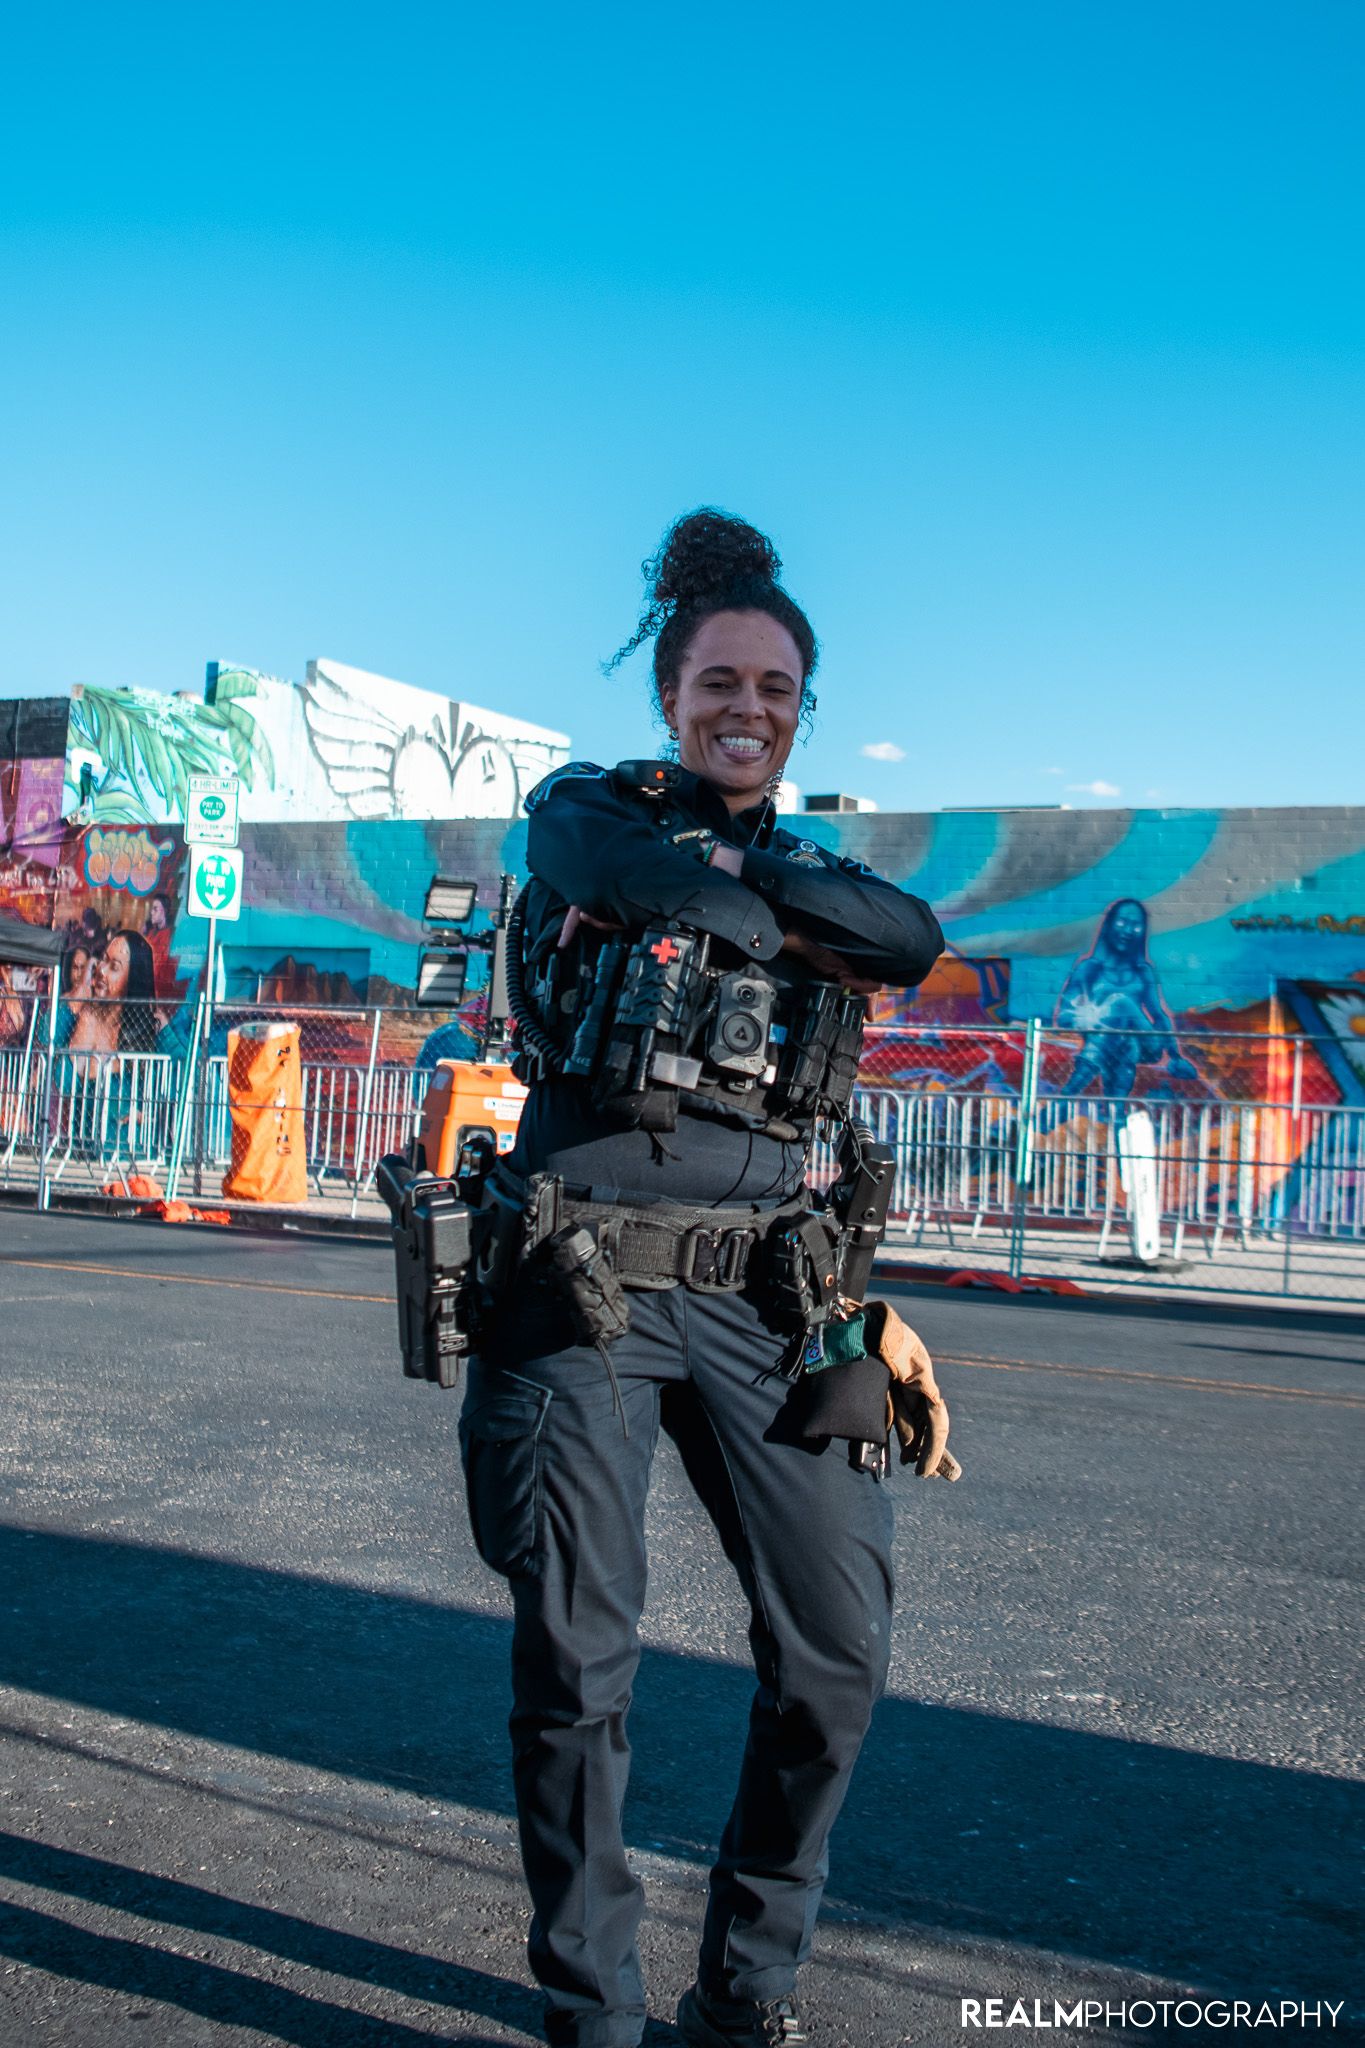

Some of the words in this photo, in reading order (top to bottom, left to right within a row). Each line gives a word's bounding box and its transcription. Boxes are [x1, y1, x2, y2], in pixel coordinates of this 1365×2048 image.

[202, 801, 213, 809] PAY
[215, 802, 224, 810] TO
[203, 809, 221, 817] PARK
[203, 859, 217, 874] PAY
[220, 861, 231, 876] TO
[206, 874, 226, 889] PARK
